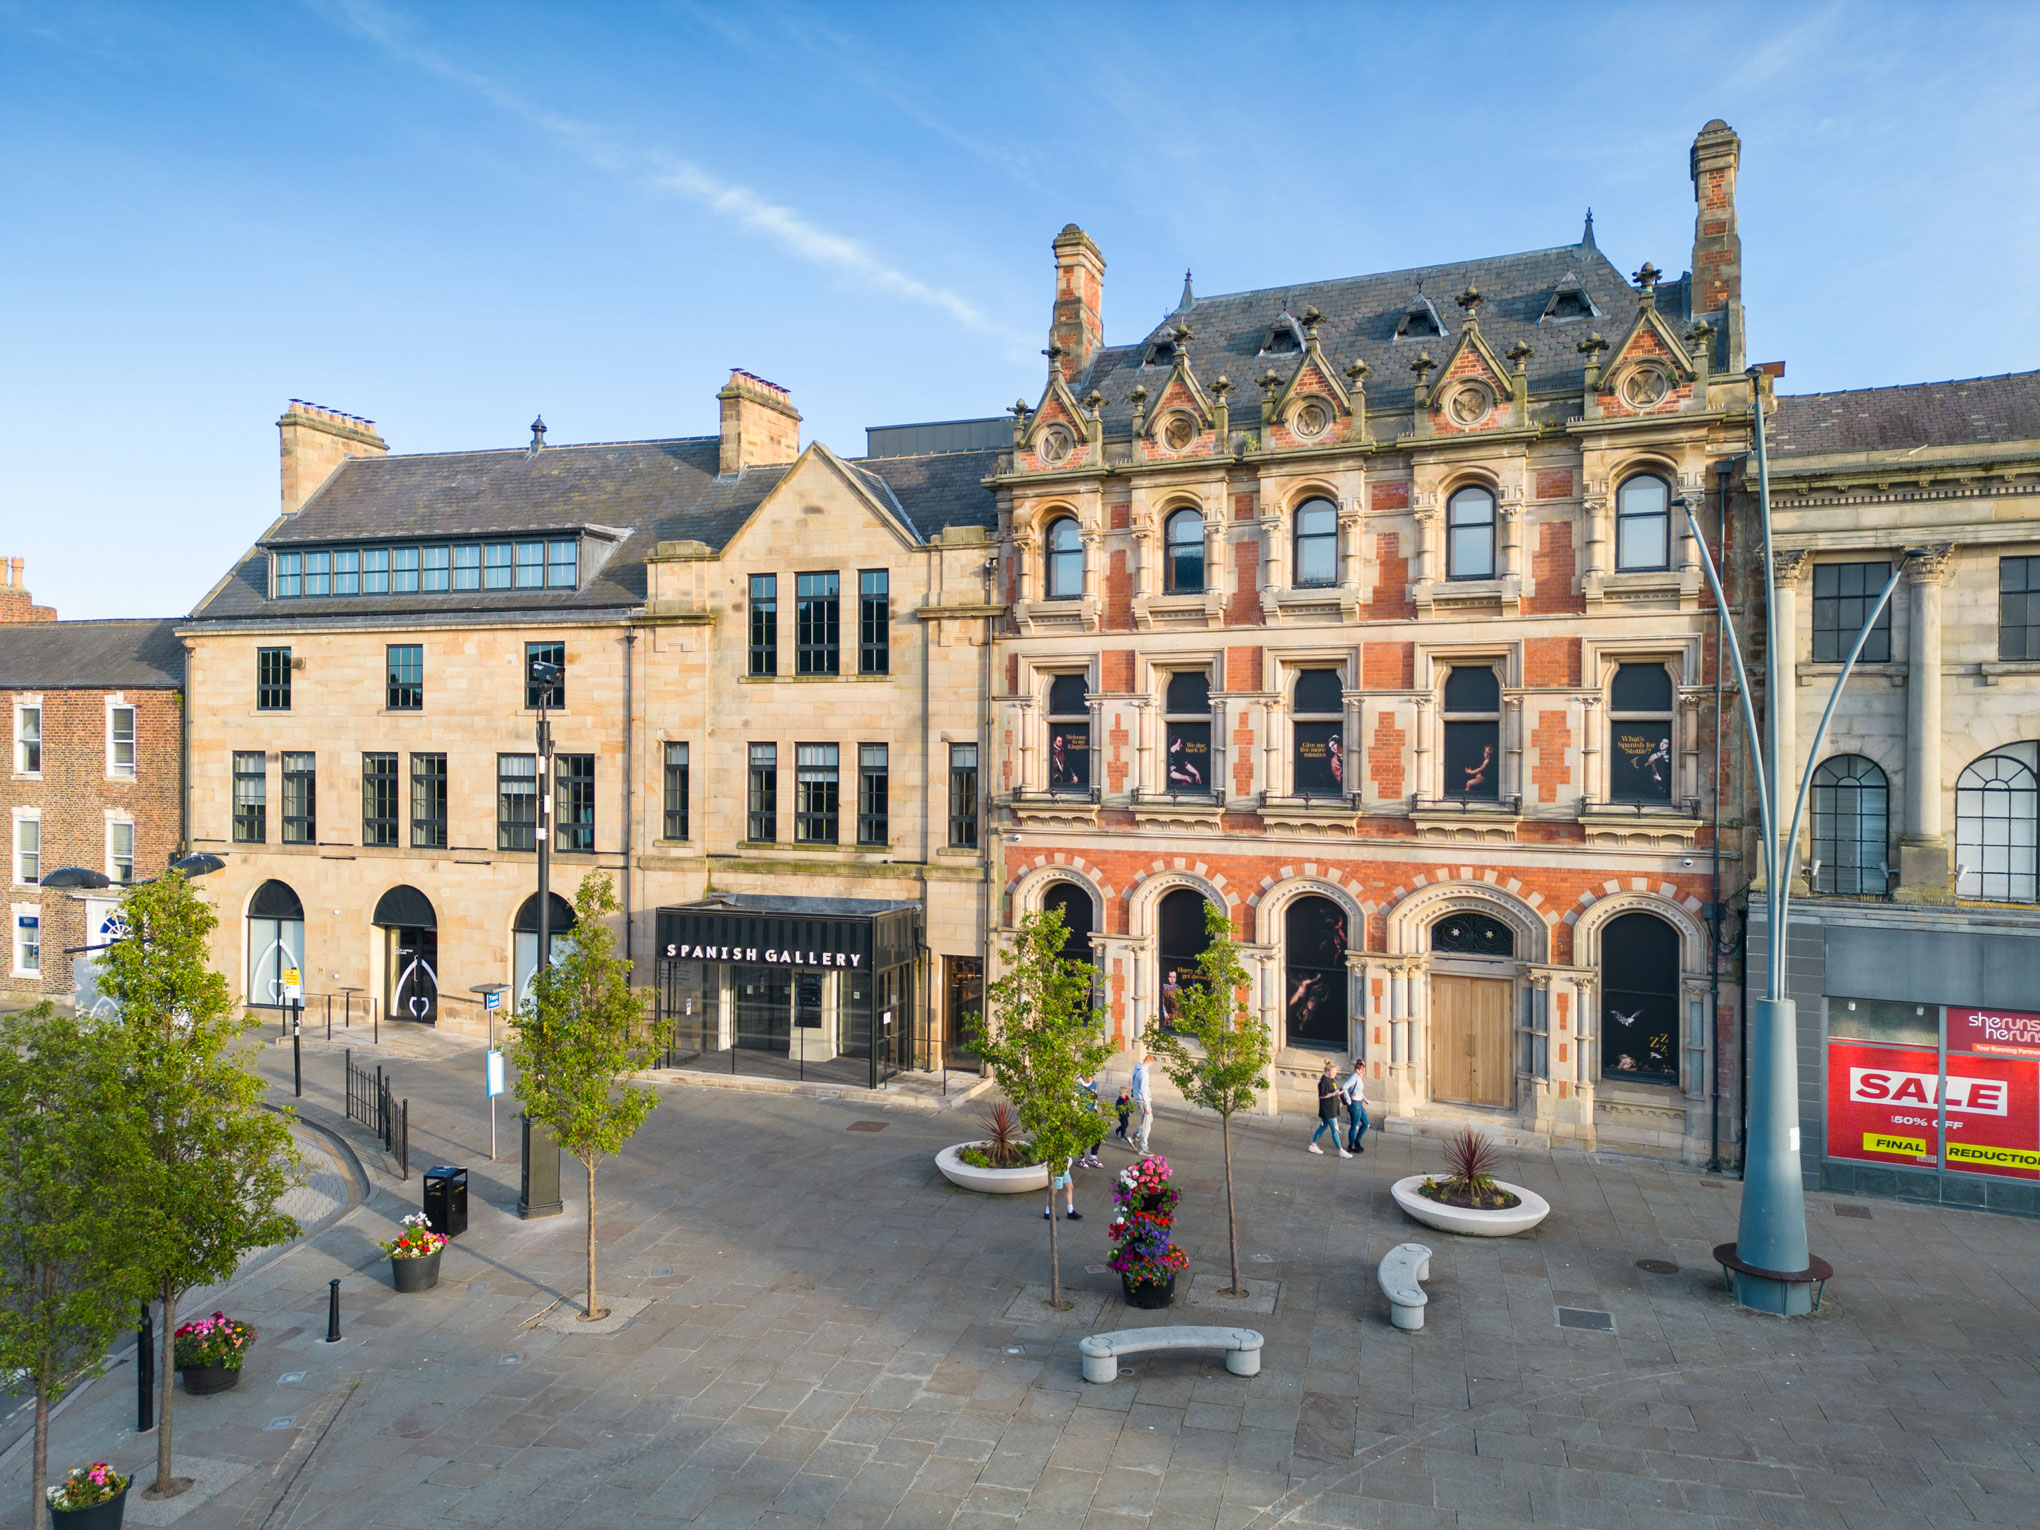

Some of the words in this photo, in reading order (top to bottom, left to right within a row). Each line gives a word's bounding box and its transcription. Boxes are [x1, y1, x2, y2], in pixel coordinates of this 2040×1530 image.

[1617, 741, 1645, 749] Spanish
[667, 944, 757, 961] SPANISH
[765, 948, 861, 967] GALLERY
[1177, 966, 1193, 975] Hurry
[1985, 1027, 2040, 1043] herun
[1991, 1045, 2017, 1055] Running
[1855, 1073, 2002, 1111] SALE
[1894, 1115, 1928, 1127] 50%
[1875, 1138, 1924, 1153] FINAL
[1948, 1146, 2040, 1166] REDUCTIO
